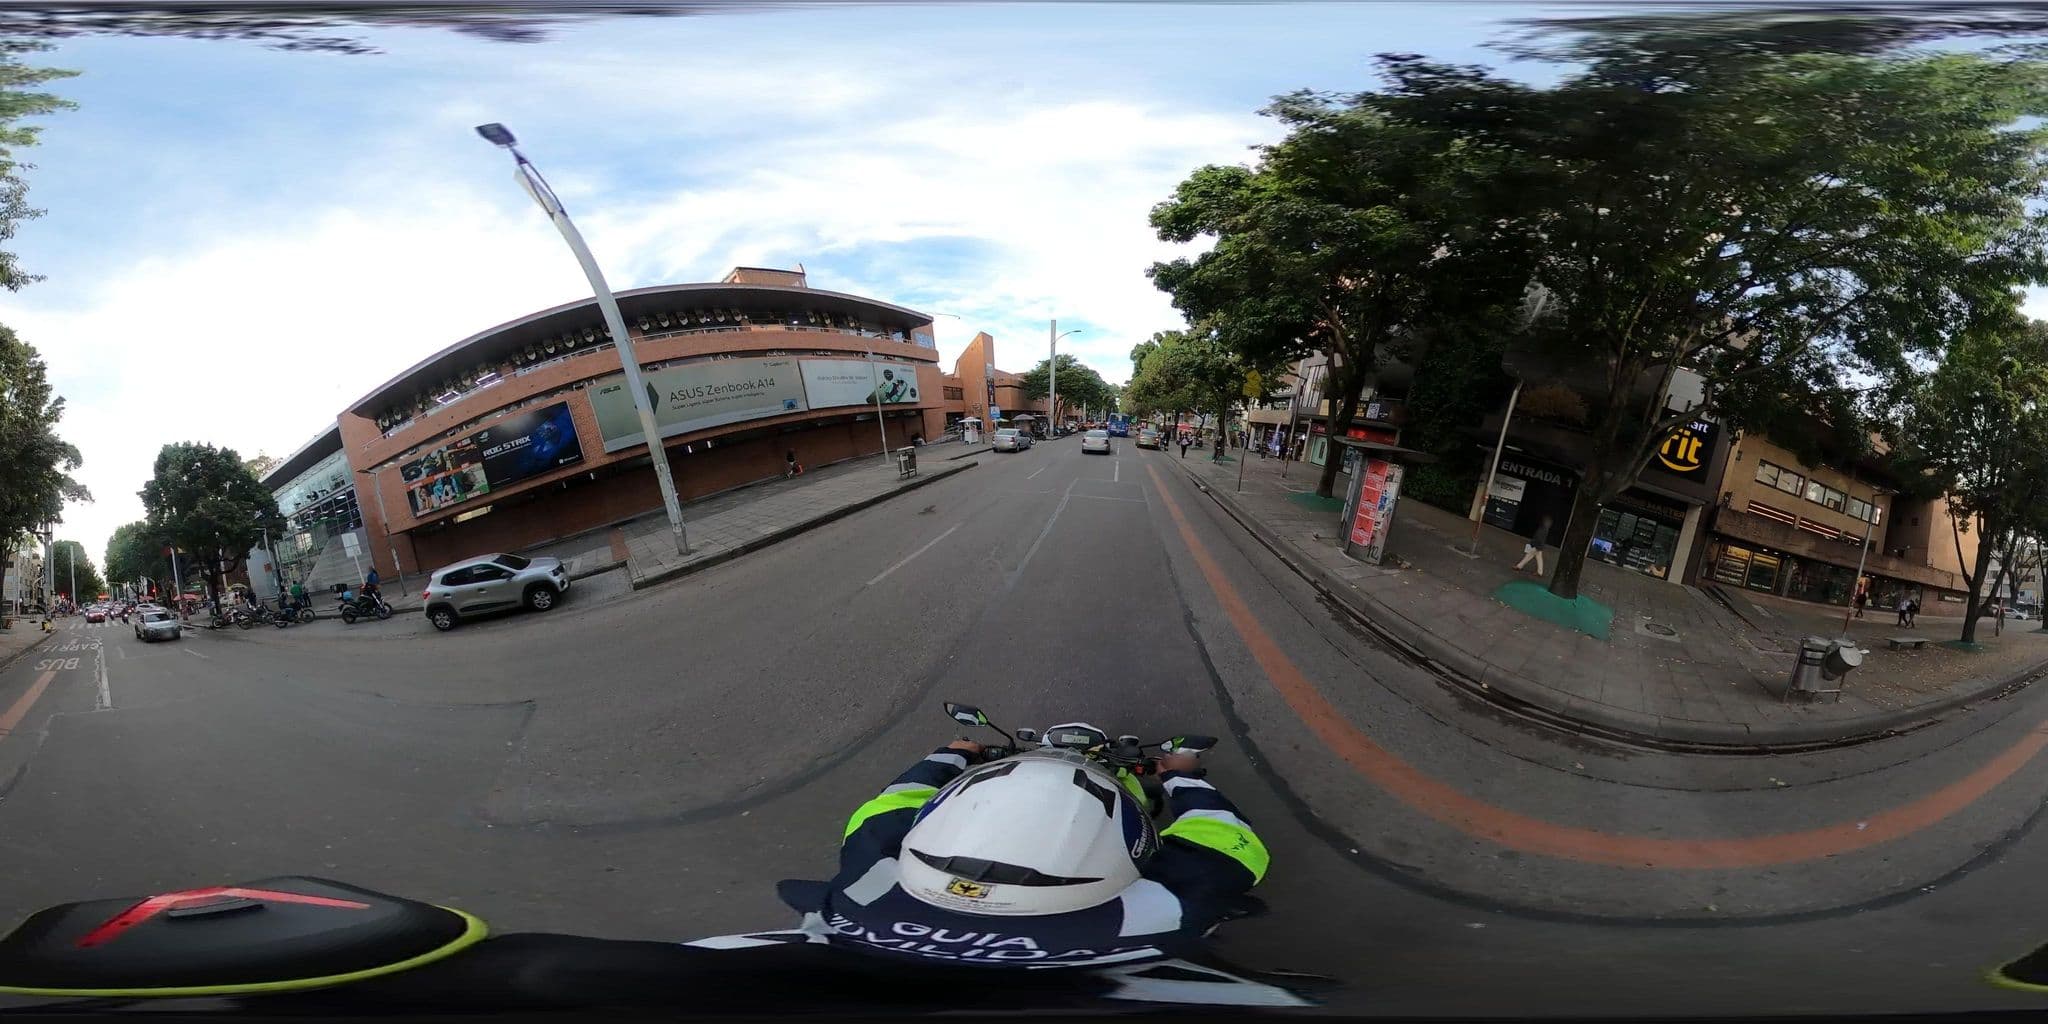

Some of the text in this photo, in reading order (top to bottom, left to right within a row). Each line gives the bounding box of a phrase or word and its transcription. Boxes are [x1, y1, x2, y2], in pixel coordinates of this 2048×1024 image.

[670, 386, 704, 403] ASUS
[707, 381, 757, 396] Zenbook
[757, 377, 776, 390] A14
[482, 444, 503, 458] ROG
[502, 435, 532, 450] STRIX
[1501, 460, 1573, 489] ENTRADA 1
[34, 657, 80, 671] BUS
[891, 921, 1040, 951] GUIA
